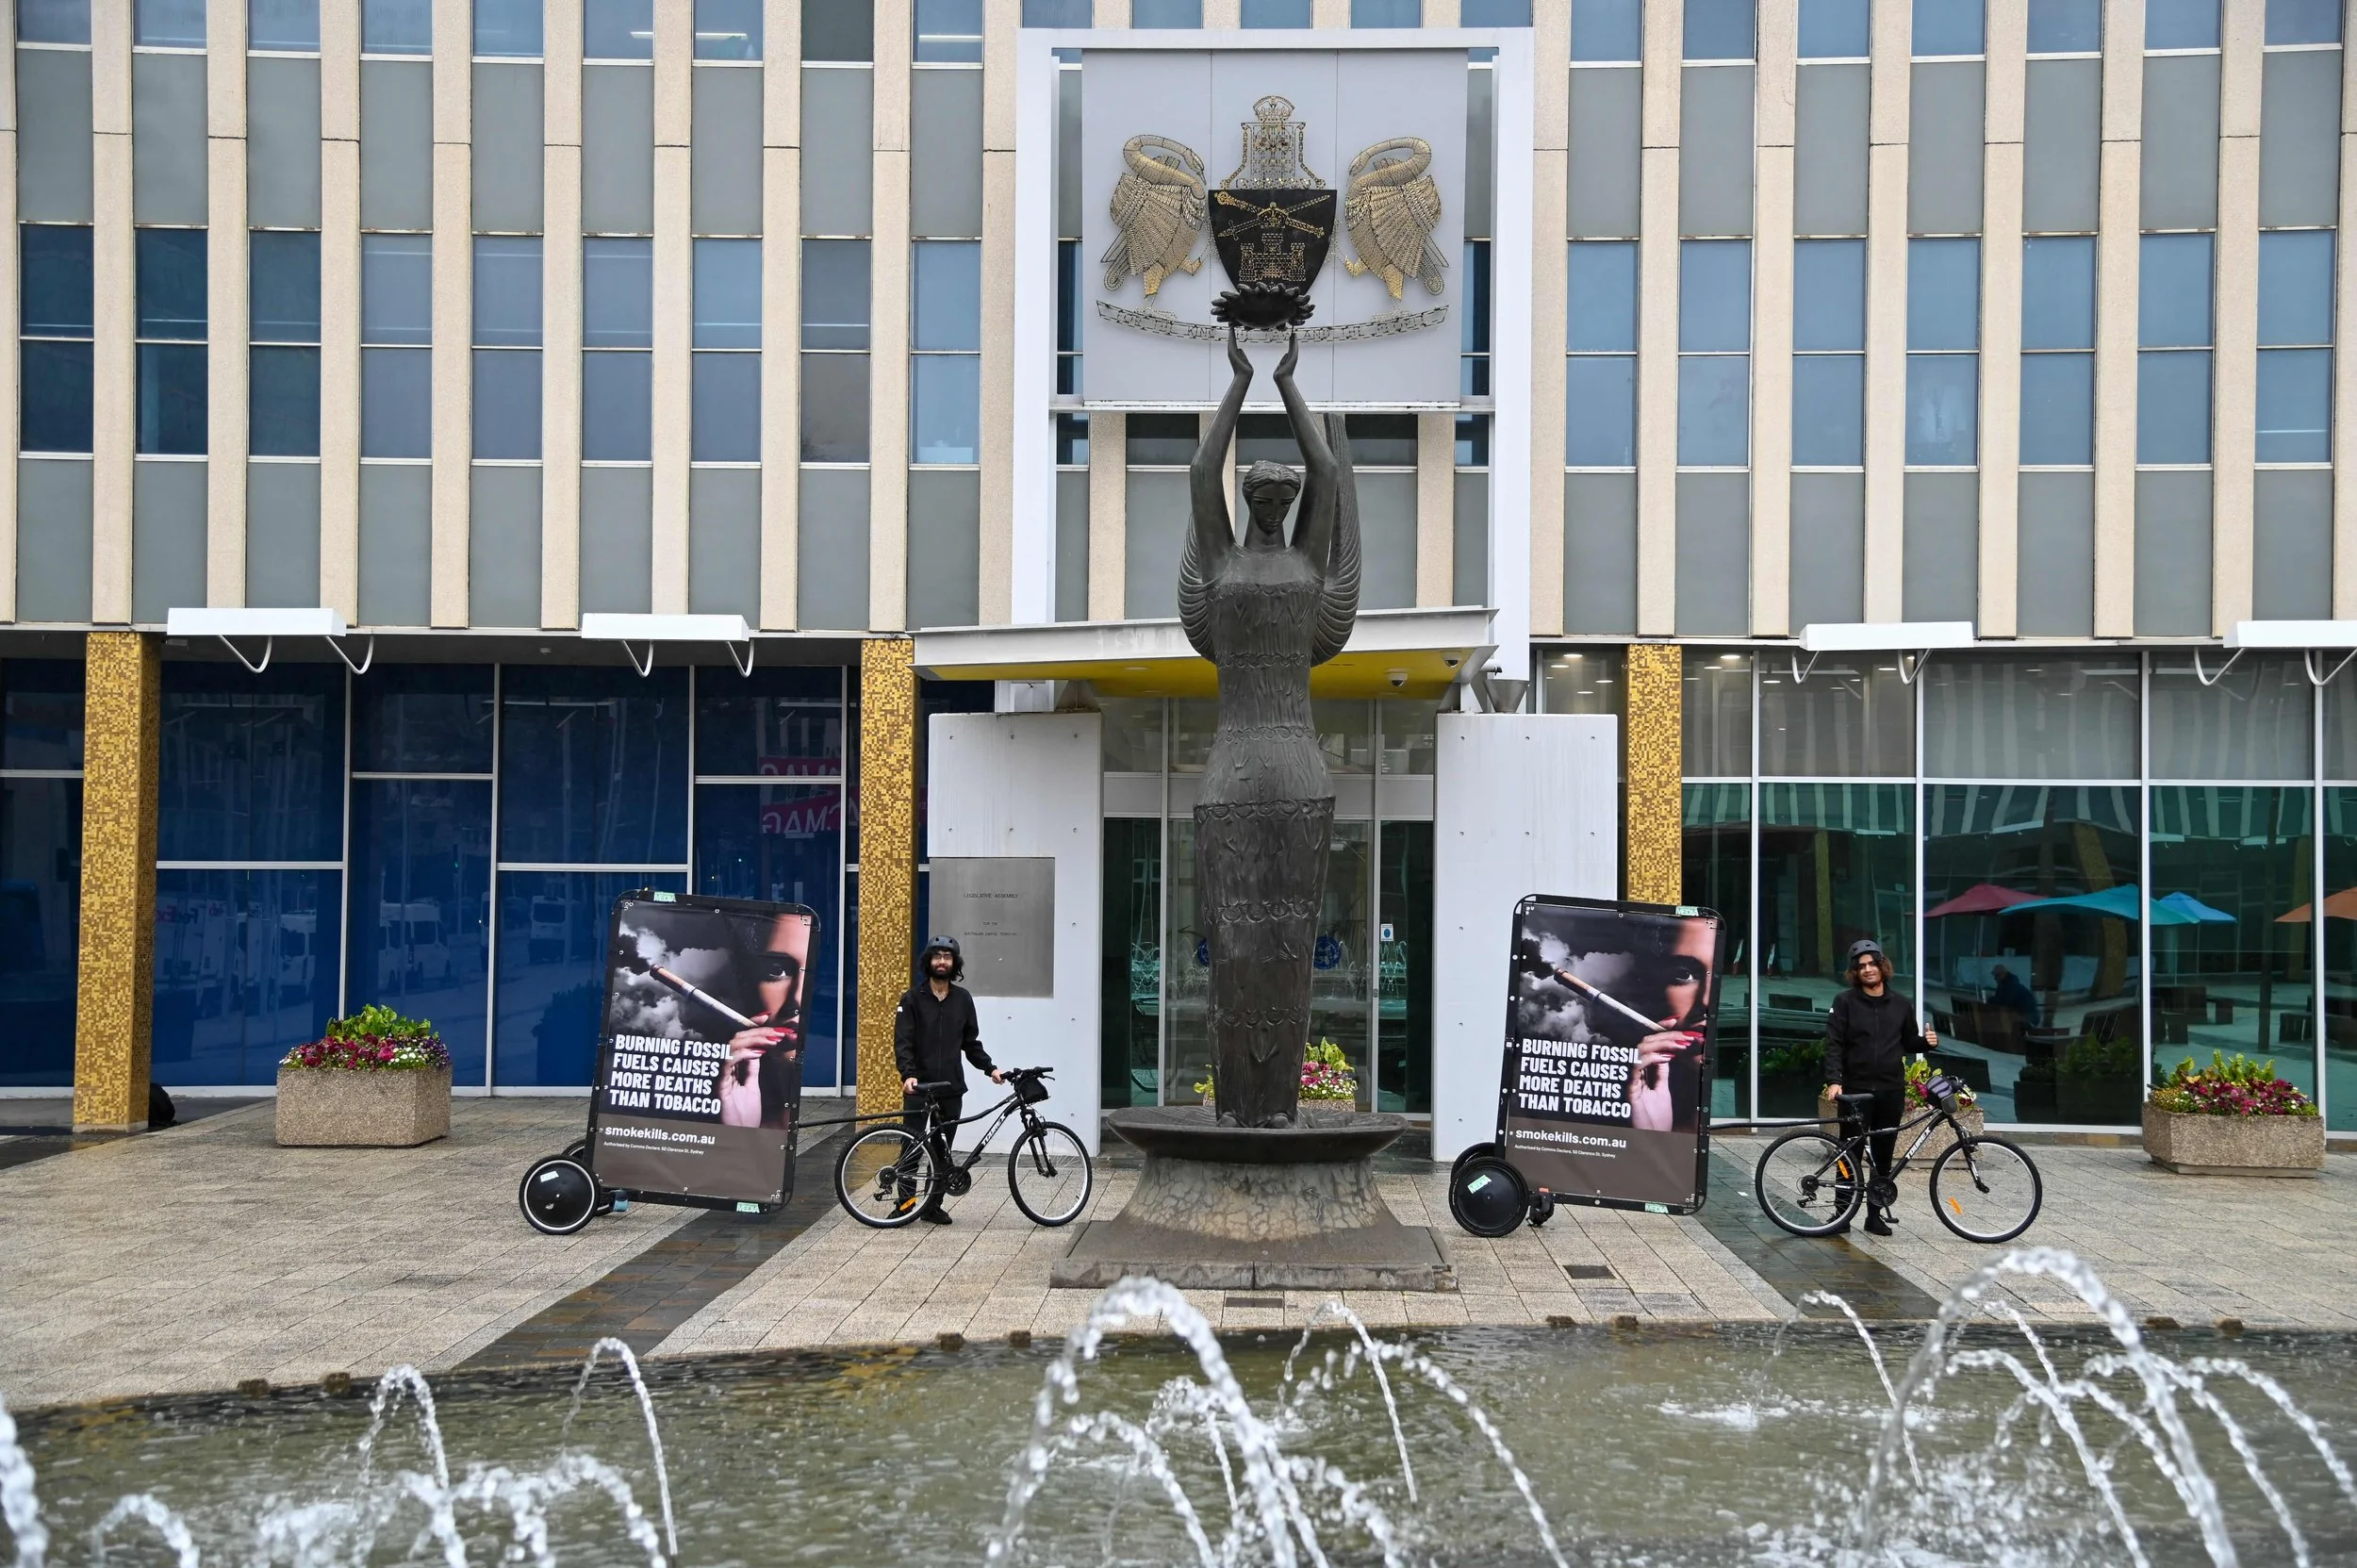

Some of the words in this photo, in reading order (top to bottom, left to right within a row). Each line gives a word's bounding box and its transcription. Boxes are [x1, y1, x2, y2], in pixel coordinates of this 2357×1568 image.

[615, 1034, 681, 1055] BURNING
[684, 1040, 733, 1060] FOSSIL
[1522, 1038, 1588, 1059] BURNING
[1591, 1045, 1642, 1065] FOSSIL
[613, 1052, 659, 1071] FUELS
[662, 1057, 719, 1077] CAUSES
[1521, 1056, 1567, 1075] FUELS
[1570, 1061, 1628, 1081] CAUSES
[611, 1071, 651, 1089] MORE
[654, 1075, 712, 1095] DEATHS
[1519, 1075, 1559, 1093] MORE
[1563, 1079, 1622, 1098] DEATHS
[610, 1089, 650, 1108] THAN
[654, 1094, 721, 1114] TOBACCO
[1519, 1093, 1558, 1112] THAN
[1563, 1097, 1631, 1118] TOBACCO
[605, 1126, 716, 1145] smokekills.com.au
[1515, 1130, 1626, 1148] smokekills.com.au
[1905, 1127, 1931, 1160] TOUREX
